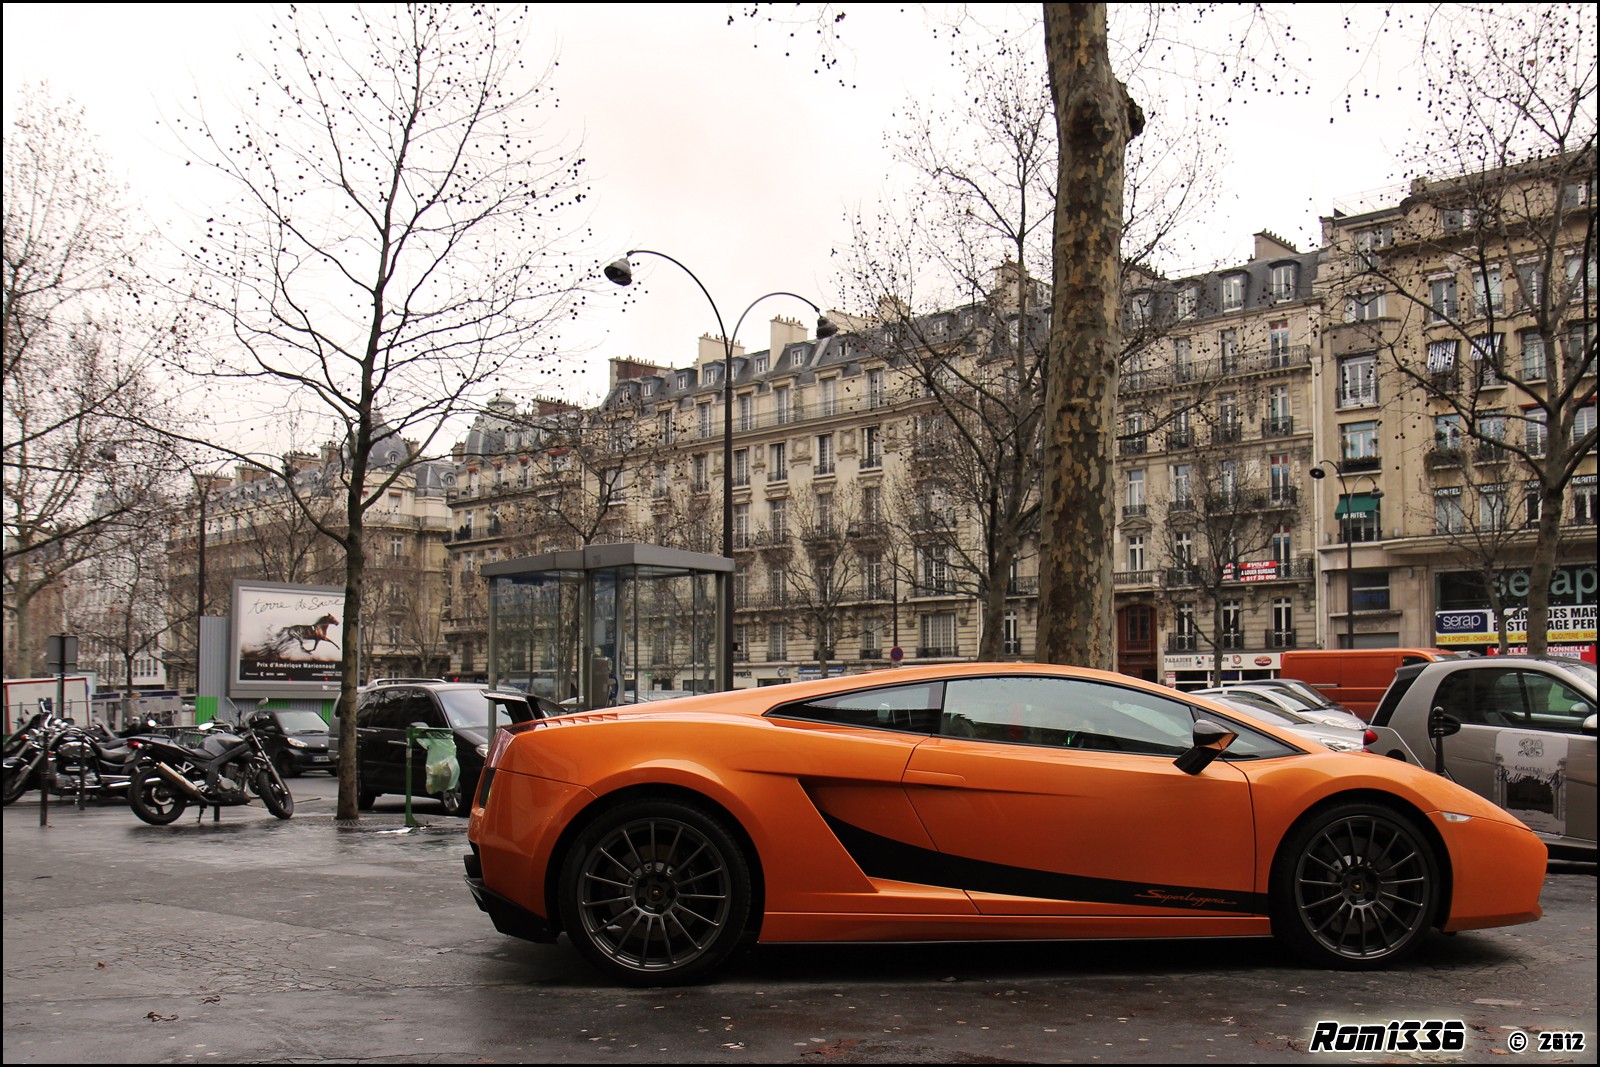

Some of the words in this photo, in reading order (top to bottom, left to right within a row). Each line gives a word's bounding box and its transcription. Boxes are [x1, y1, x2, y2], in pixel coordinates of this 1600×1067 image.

[1571, 475, 1597, 484] AGRITE
[1492, 570, 1597, 603] seap
[1513, 608, 1567, 620] GRDES
[1571, 606, 1597, 617] MAR
[1443, 615, 1481, 629] serap
[1507, 619, 1570, 631] STOAGE
[1573, 618, 1597, 629] PER
[1134, 889, 1237, 906] Superleggera
